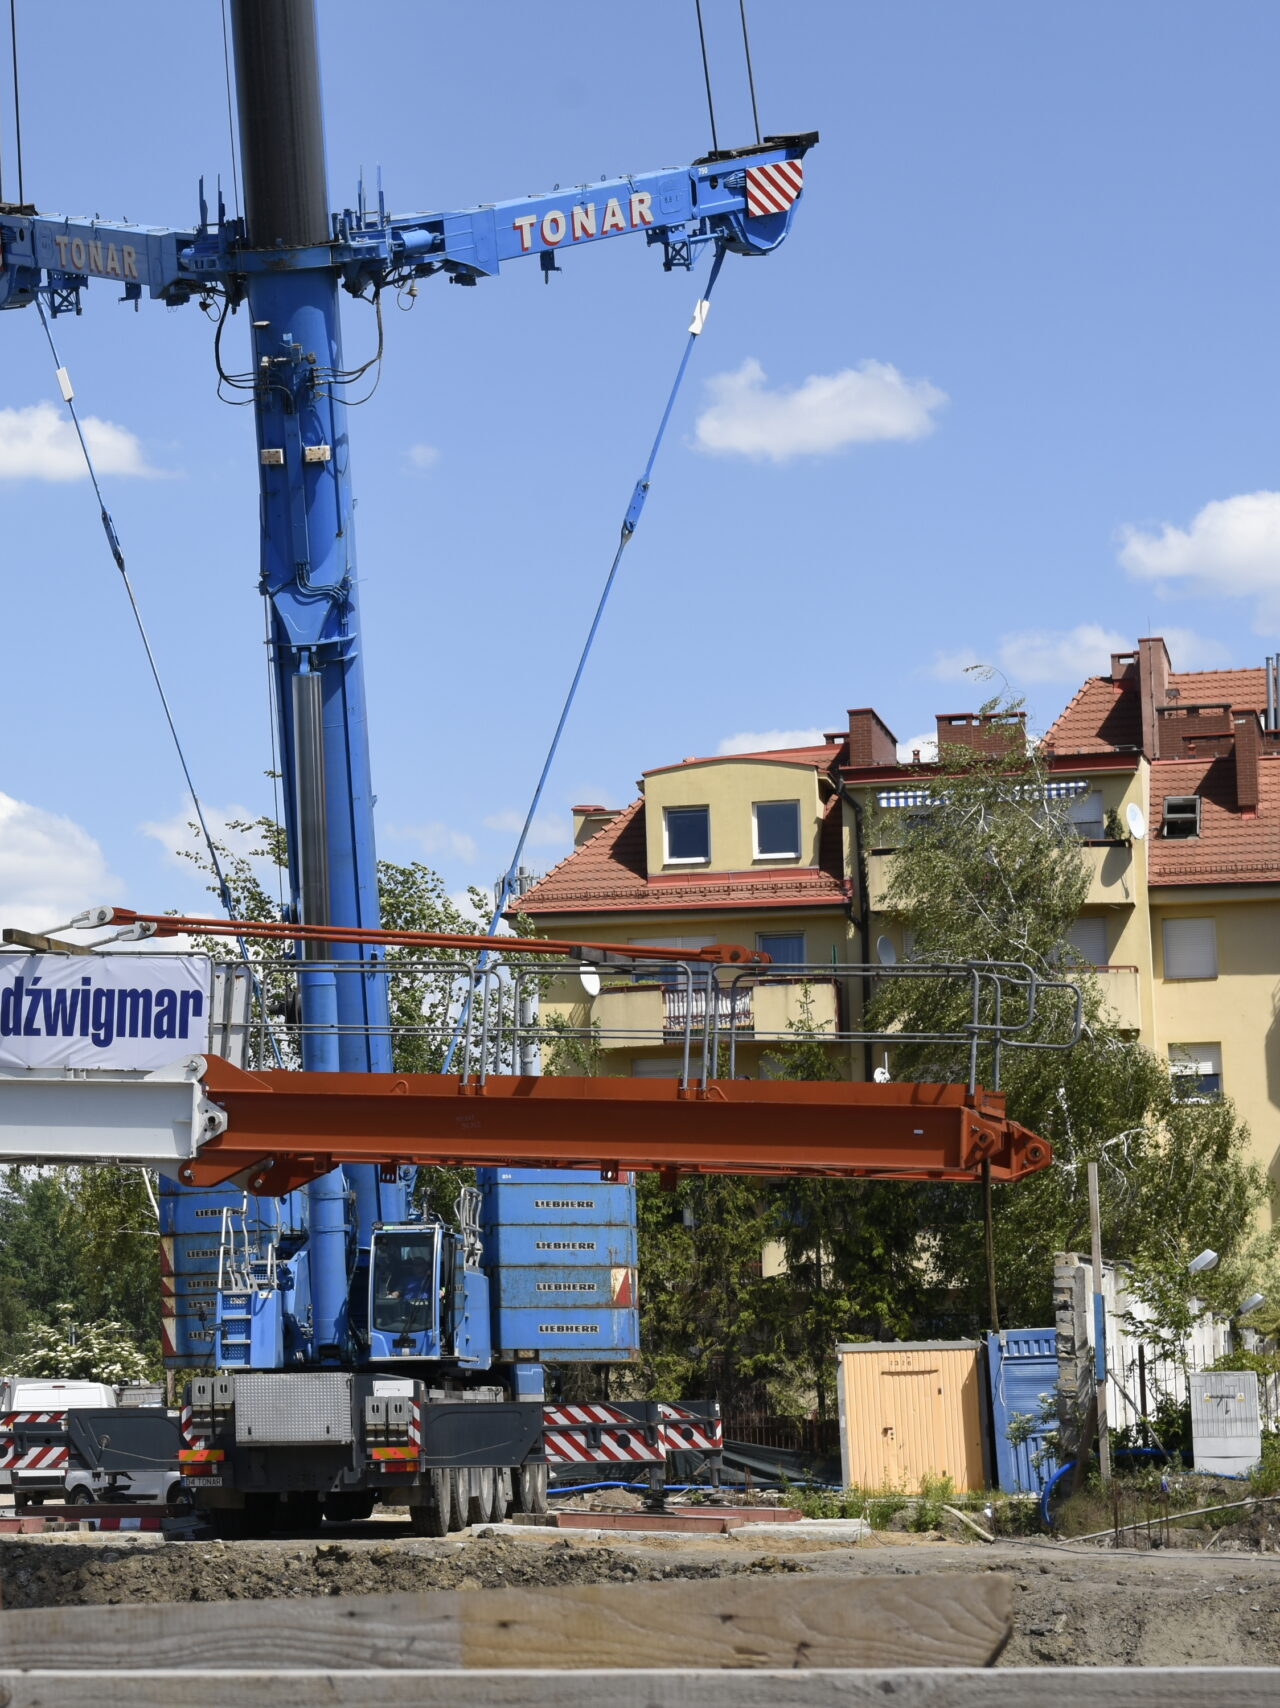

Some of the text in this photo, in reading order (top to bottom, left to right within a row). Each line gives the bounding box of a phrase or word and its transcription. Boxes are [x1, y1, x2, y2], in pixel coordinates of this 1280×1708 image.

[513, 191, 654, 251] TONAR
[54, 235, 138, 279] TONAR
[0, 976, 204, 1048] dźwigmar
[535, 1200, 594, 1208] LIEBHERR
[536, 1242, 595, 1250] LIEBHERR
[536, 1283, 595, 1291] LIEBHERR
[539, 1325, 598, 1333] LIEBHERR
